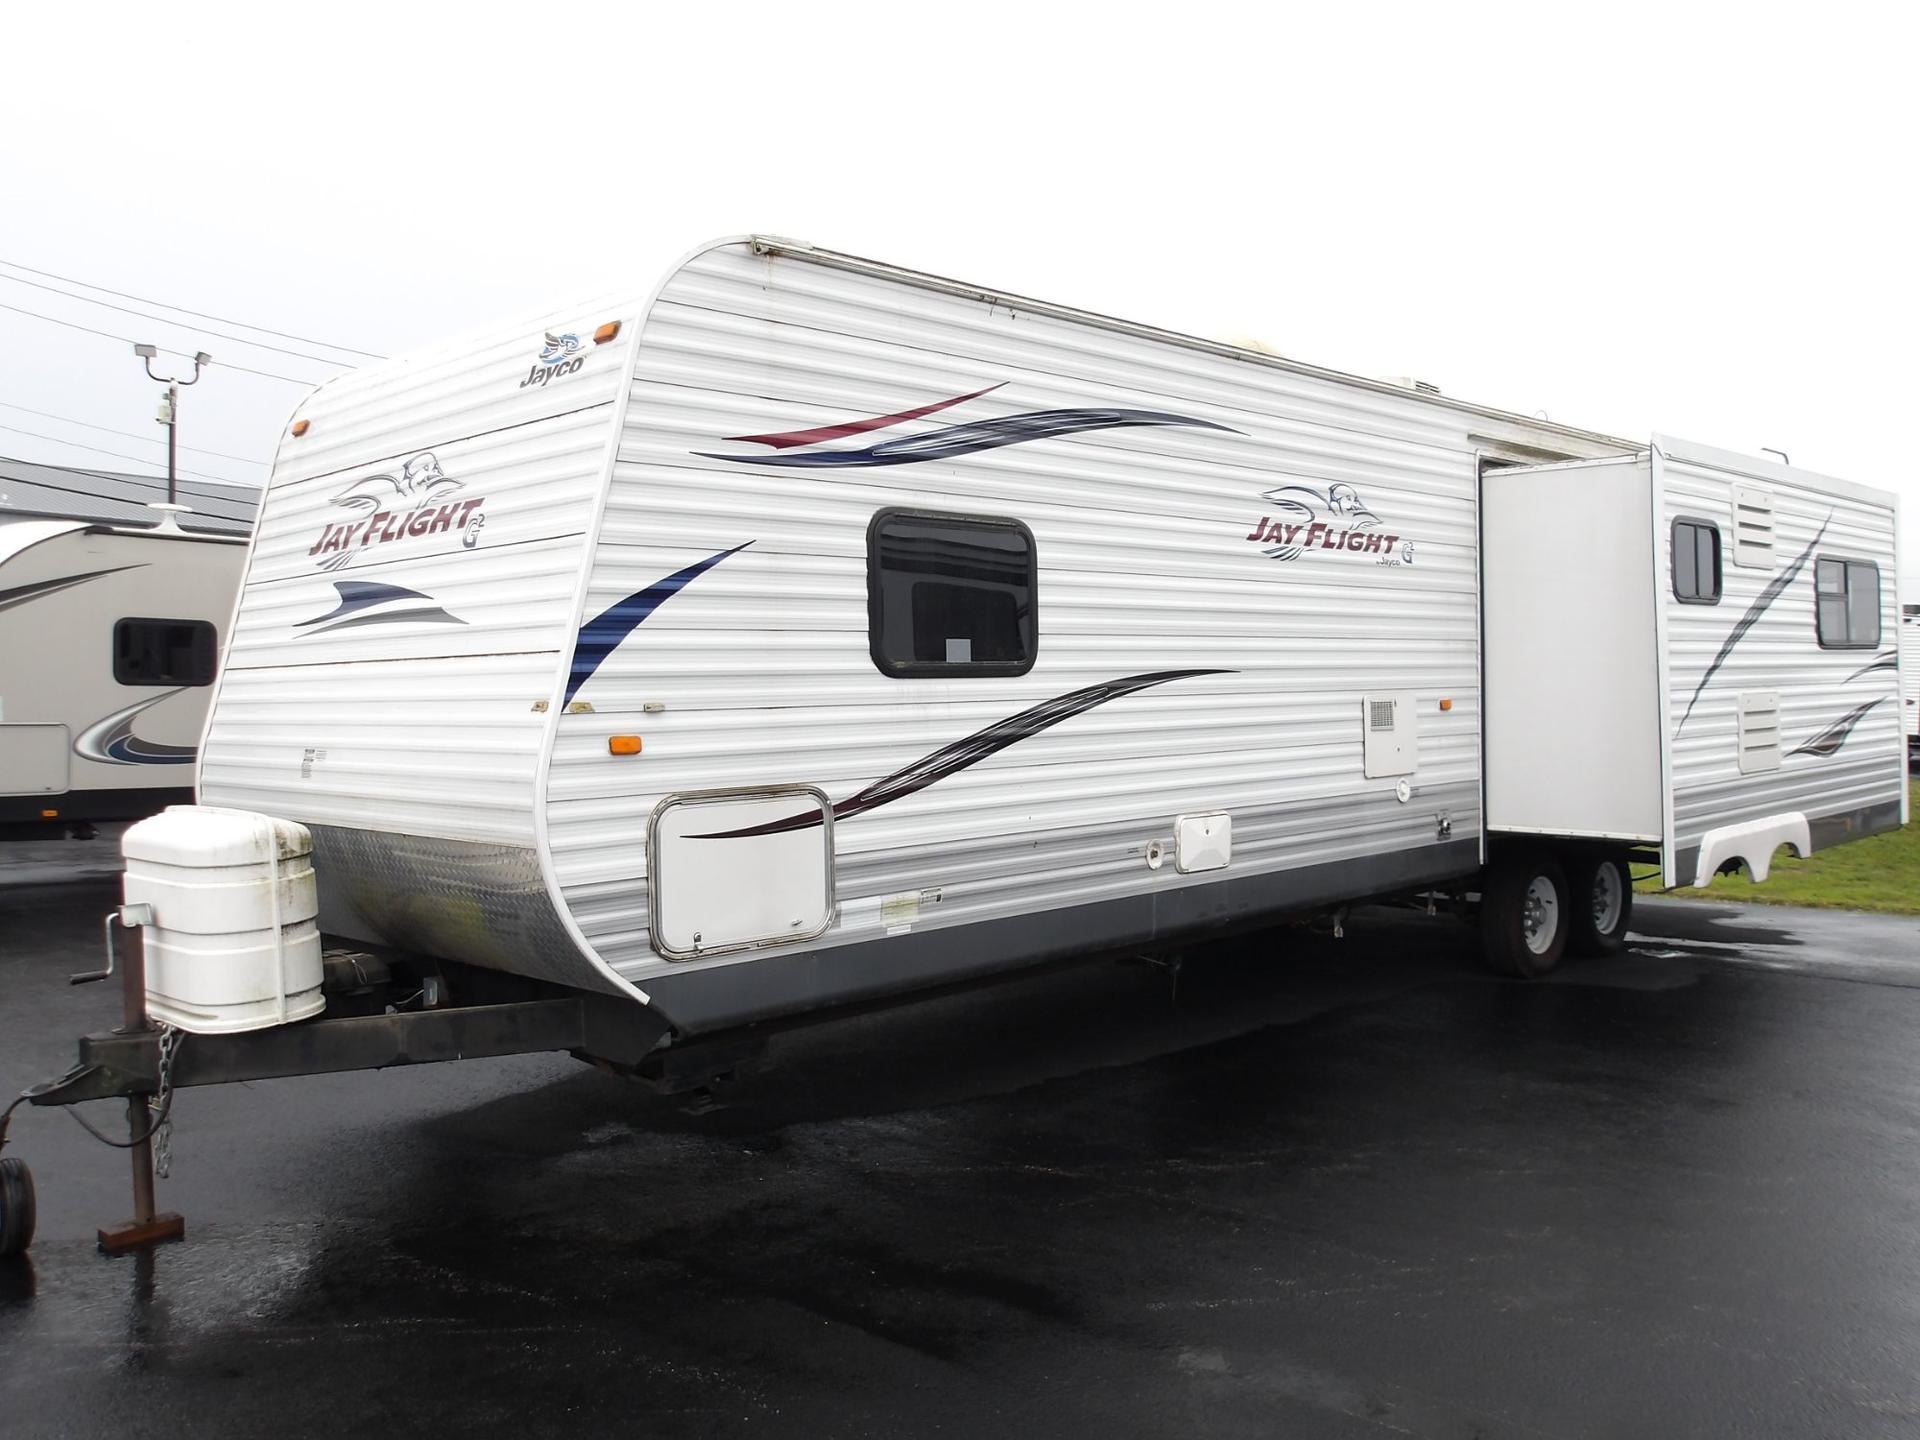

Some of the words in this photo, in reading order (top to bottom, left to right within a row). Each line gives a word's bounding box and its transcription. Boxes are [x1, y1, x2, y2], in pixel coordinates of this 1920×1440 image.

[520, 357, 585, 388] Jayco
[308, 522, 364, 556] JAY
[360, 497, 486, 546] FLIGHT
[1246, 516, 1304, 545] JAY
[1303, 522, 1400, 554] FLIGHT
